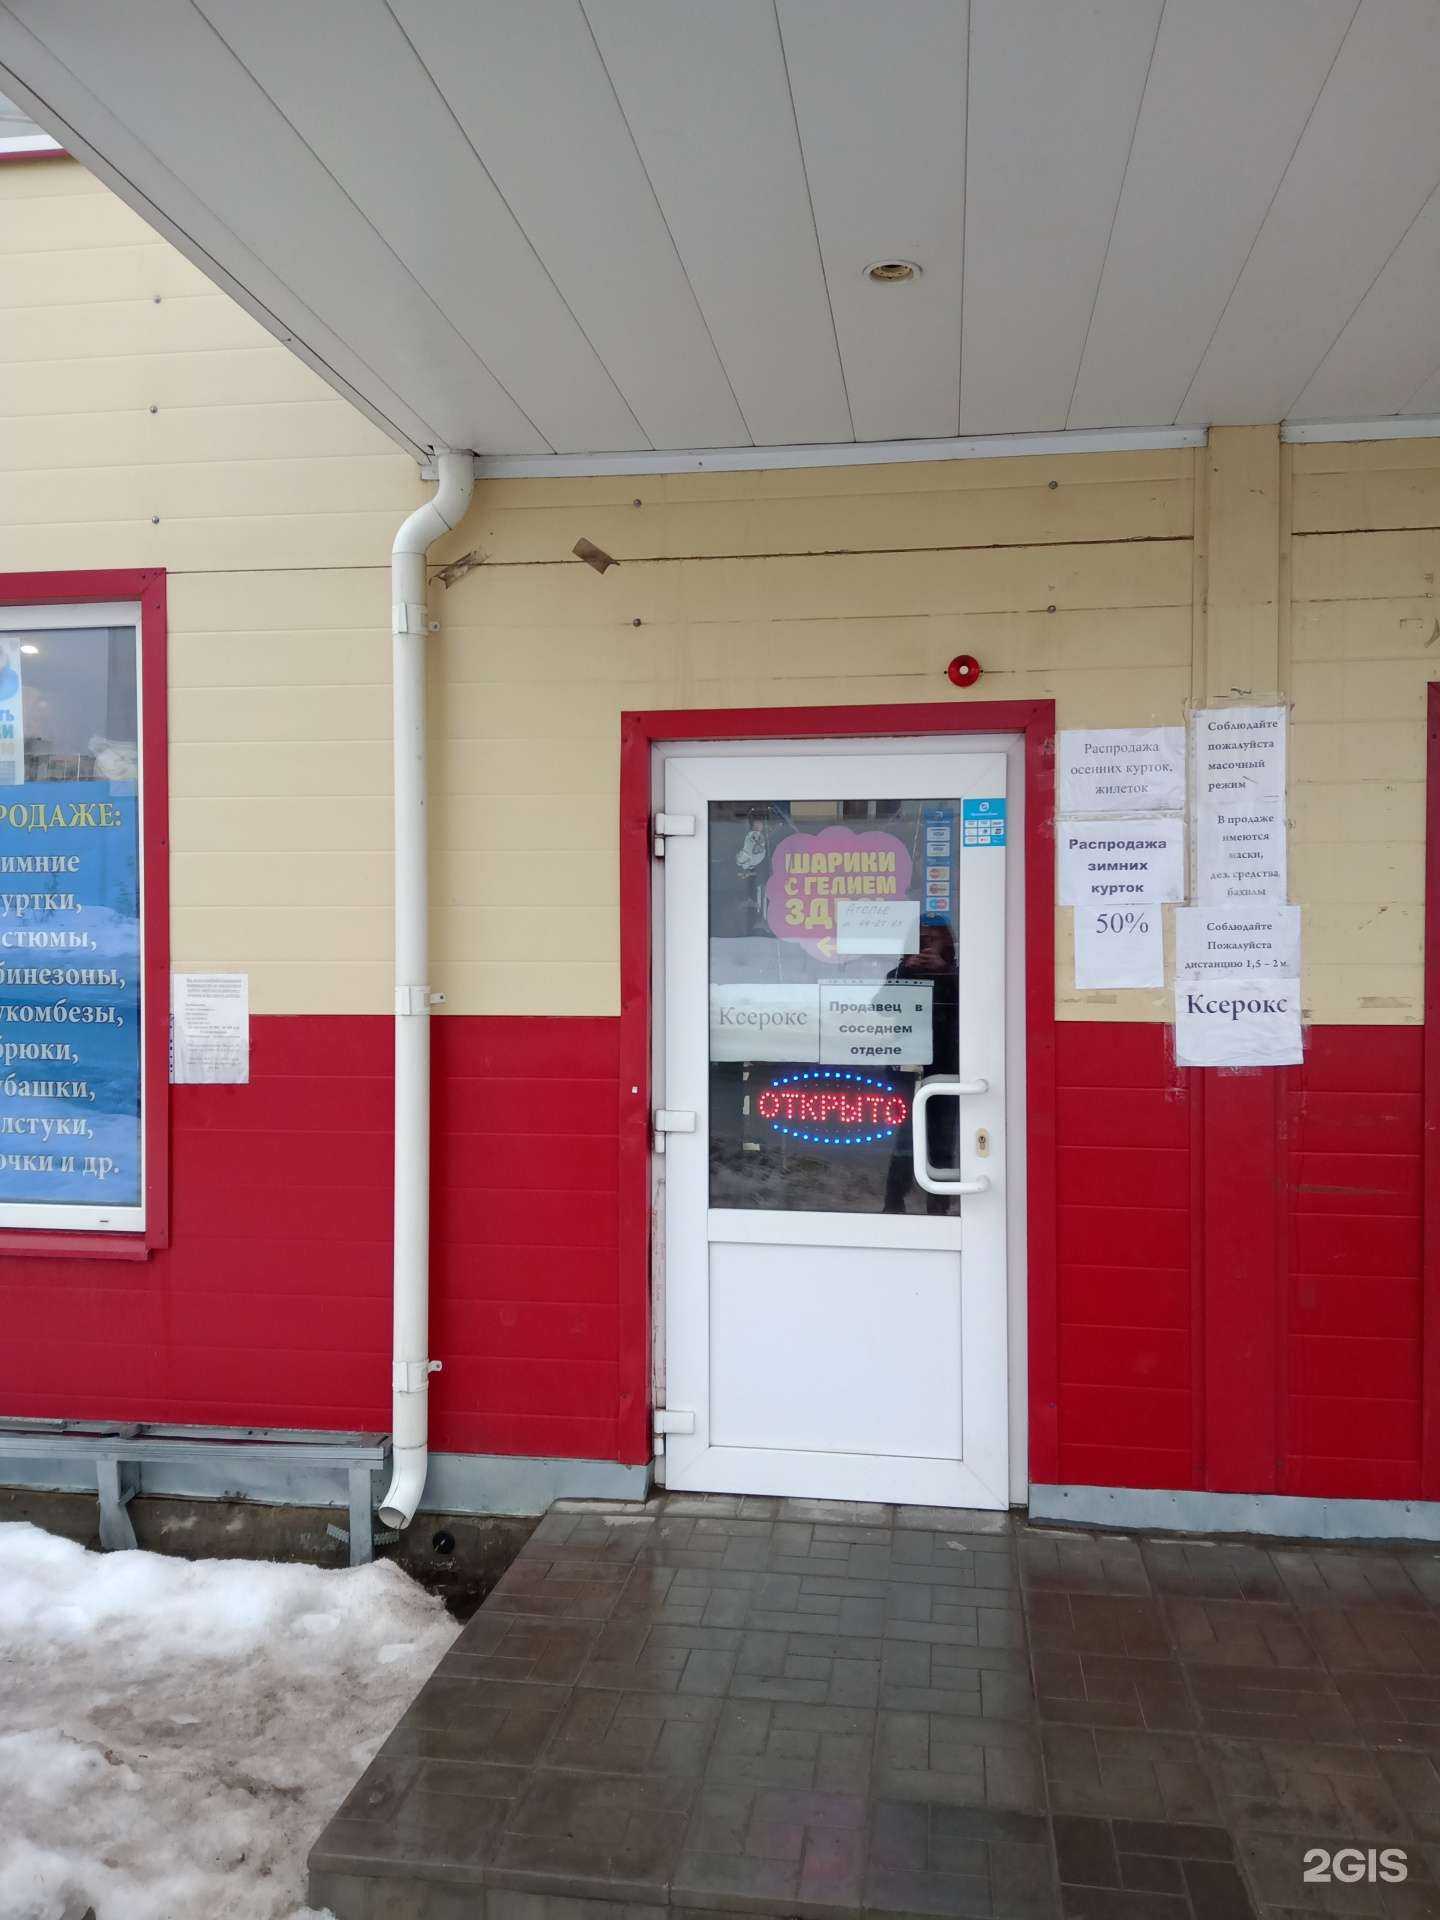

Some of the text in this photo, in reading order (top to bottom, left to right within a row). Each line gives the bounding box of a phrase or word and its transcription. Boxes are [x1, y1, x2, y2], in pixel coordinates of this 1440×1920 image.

[1207, 720, 1279, 732] Соблюдайте
[1084, 743, 1159, 756] Распродажа
[1207, 740, 1275, 752] пожалуйста
[1070, 764, 1122, 775] осенних
[1208, 760, 1265, 770] масочный
[1095, 784, 1149, 795] жилеток
[1208, 782, 1246, 793] режим
[1217, 815, 1275, 826] В продаже
[1222, 833, 1269, 842] имеются
[1069, 838, 1167, 851] Распродажа
[1, 855, 80, 873] имние
[784, 852, 896, 874] ШАРИКИ
[1088, 861, 1148, 871] зимних
[804, 876, 897, 896] ГЕЛИЕМ
[1091, 884, 1144, 896] курток
[2, 893, 82, 917] уртки,
[1096, 912, 1149, 934] 50%
[1206, 922, 1273, 931] Соблюдайте
[1, 931, 97, 951] стюмы,
[1207, 941, 1272, 952] Пожалуйста
[1185, 960, 1242, 969] дистанцию
[1246, 960, 1261, 969] 1,5
[1273, 959, 1278, 967] 2
[829, 1001, 923, 1014] Продавец в
[1186, 994, 1288, 1020] Ксерокс
[719, 1007, 808, 1030] Ксерокс
[839, 1024, 912, 1035] соседнем
[850, 1045, 902, 1057] отделе
[0, 1073, 96, 1100] башки,
[759, 1092, 907, 1125] ОТКРЫТО
[61, 1155, 74, 1172] и
[82, 1156, 120, 1180] др.
